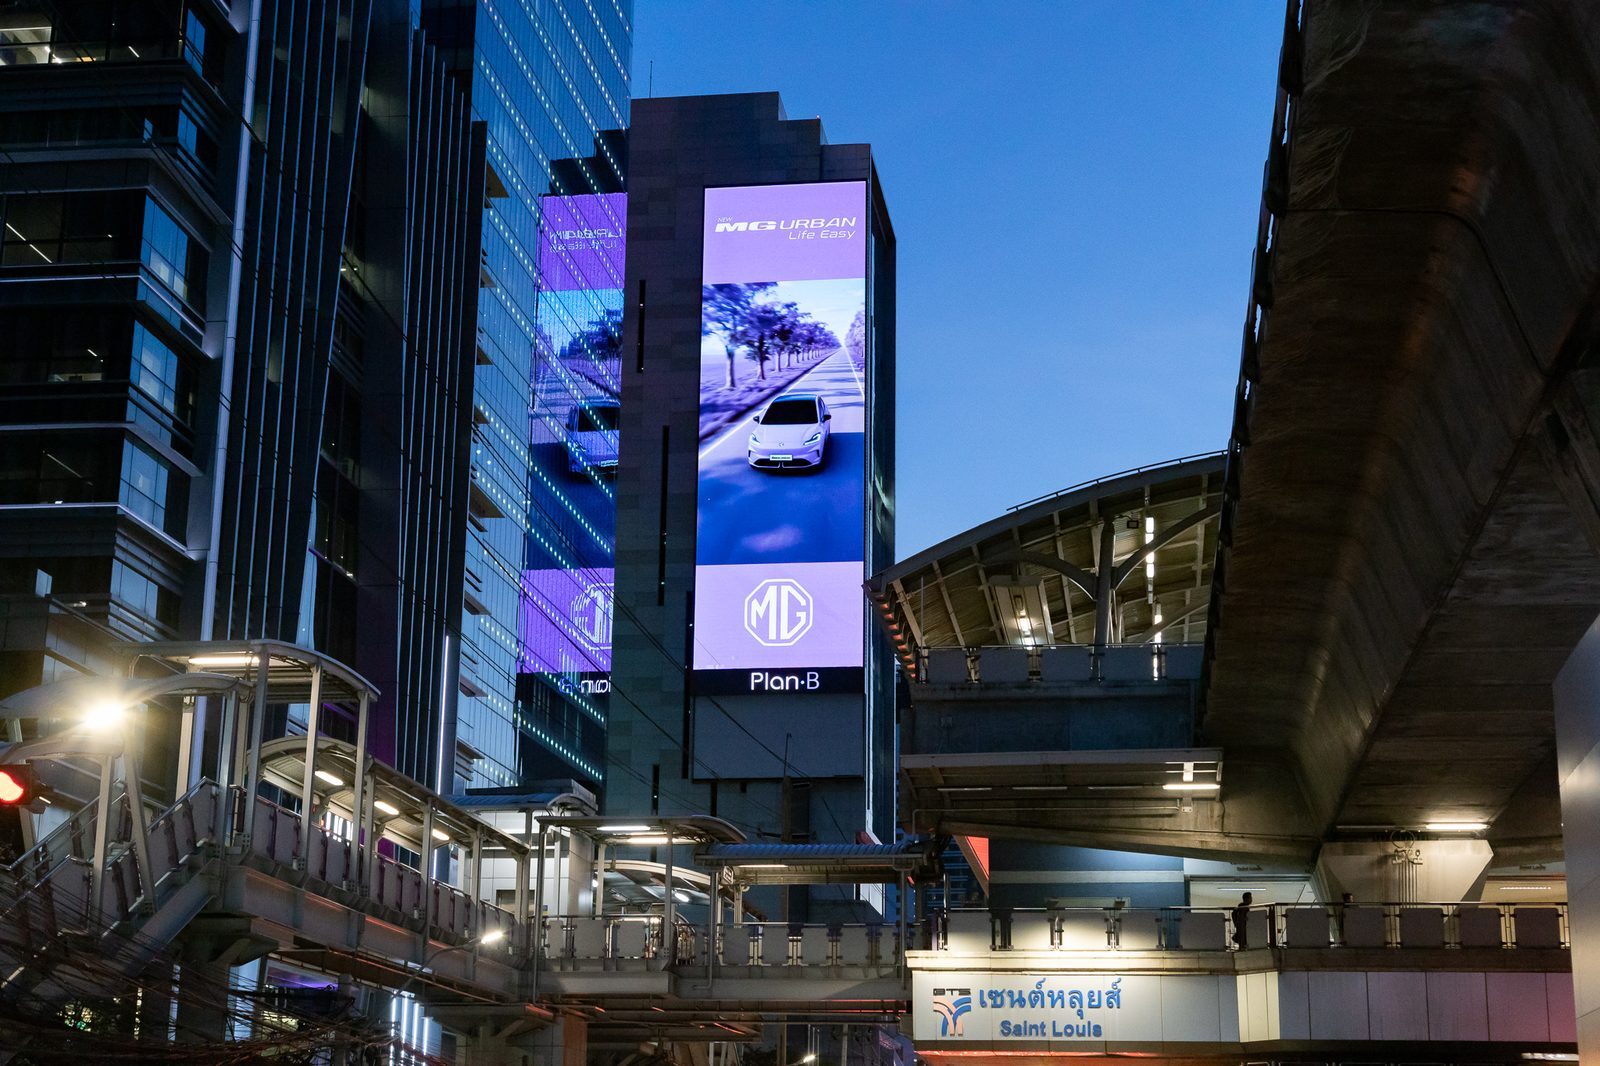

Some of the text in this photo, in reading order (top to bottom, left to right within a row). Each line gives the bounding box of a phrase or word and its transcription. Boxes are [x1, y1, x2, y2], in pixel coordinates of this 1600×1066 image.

[715, 217, 856, 232] MG URBAN
[789, 229, 856, 240] Life Easy
[751, 585, 807, 640] MG
[933, 988, 971, 996] BTS
[979, 978, 1122, 1019] เซนต์หลุยส์
[1000, 1020, 1102, 1037] Saint Louis
